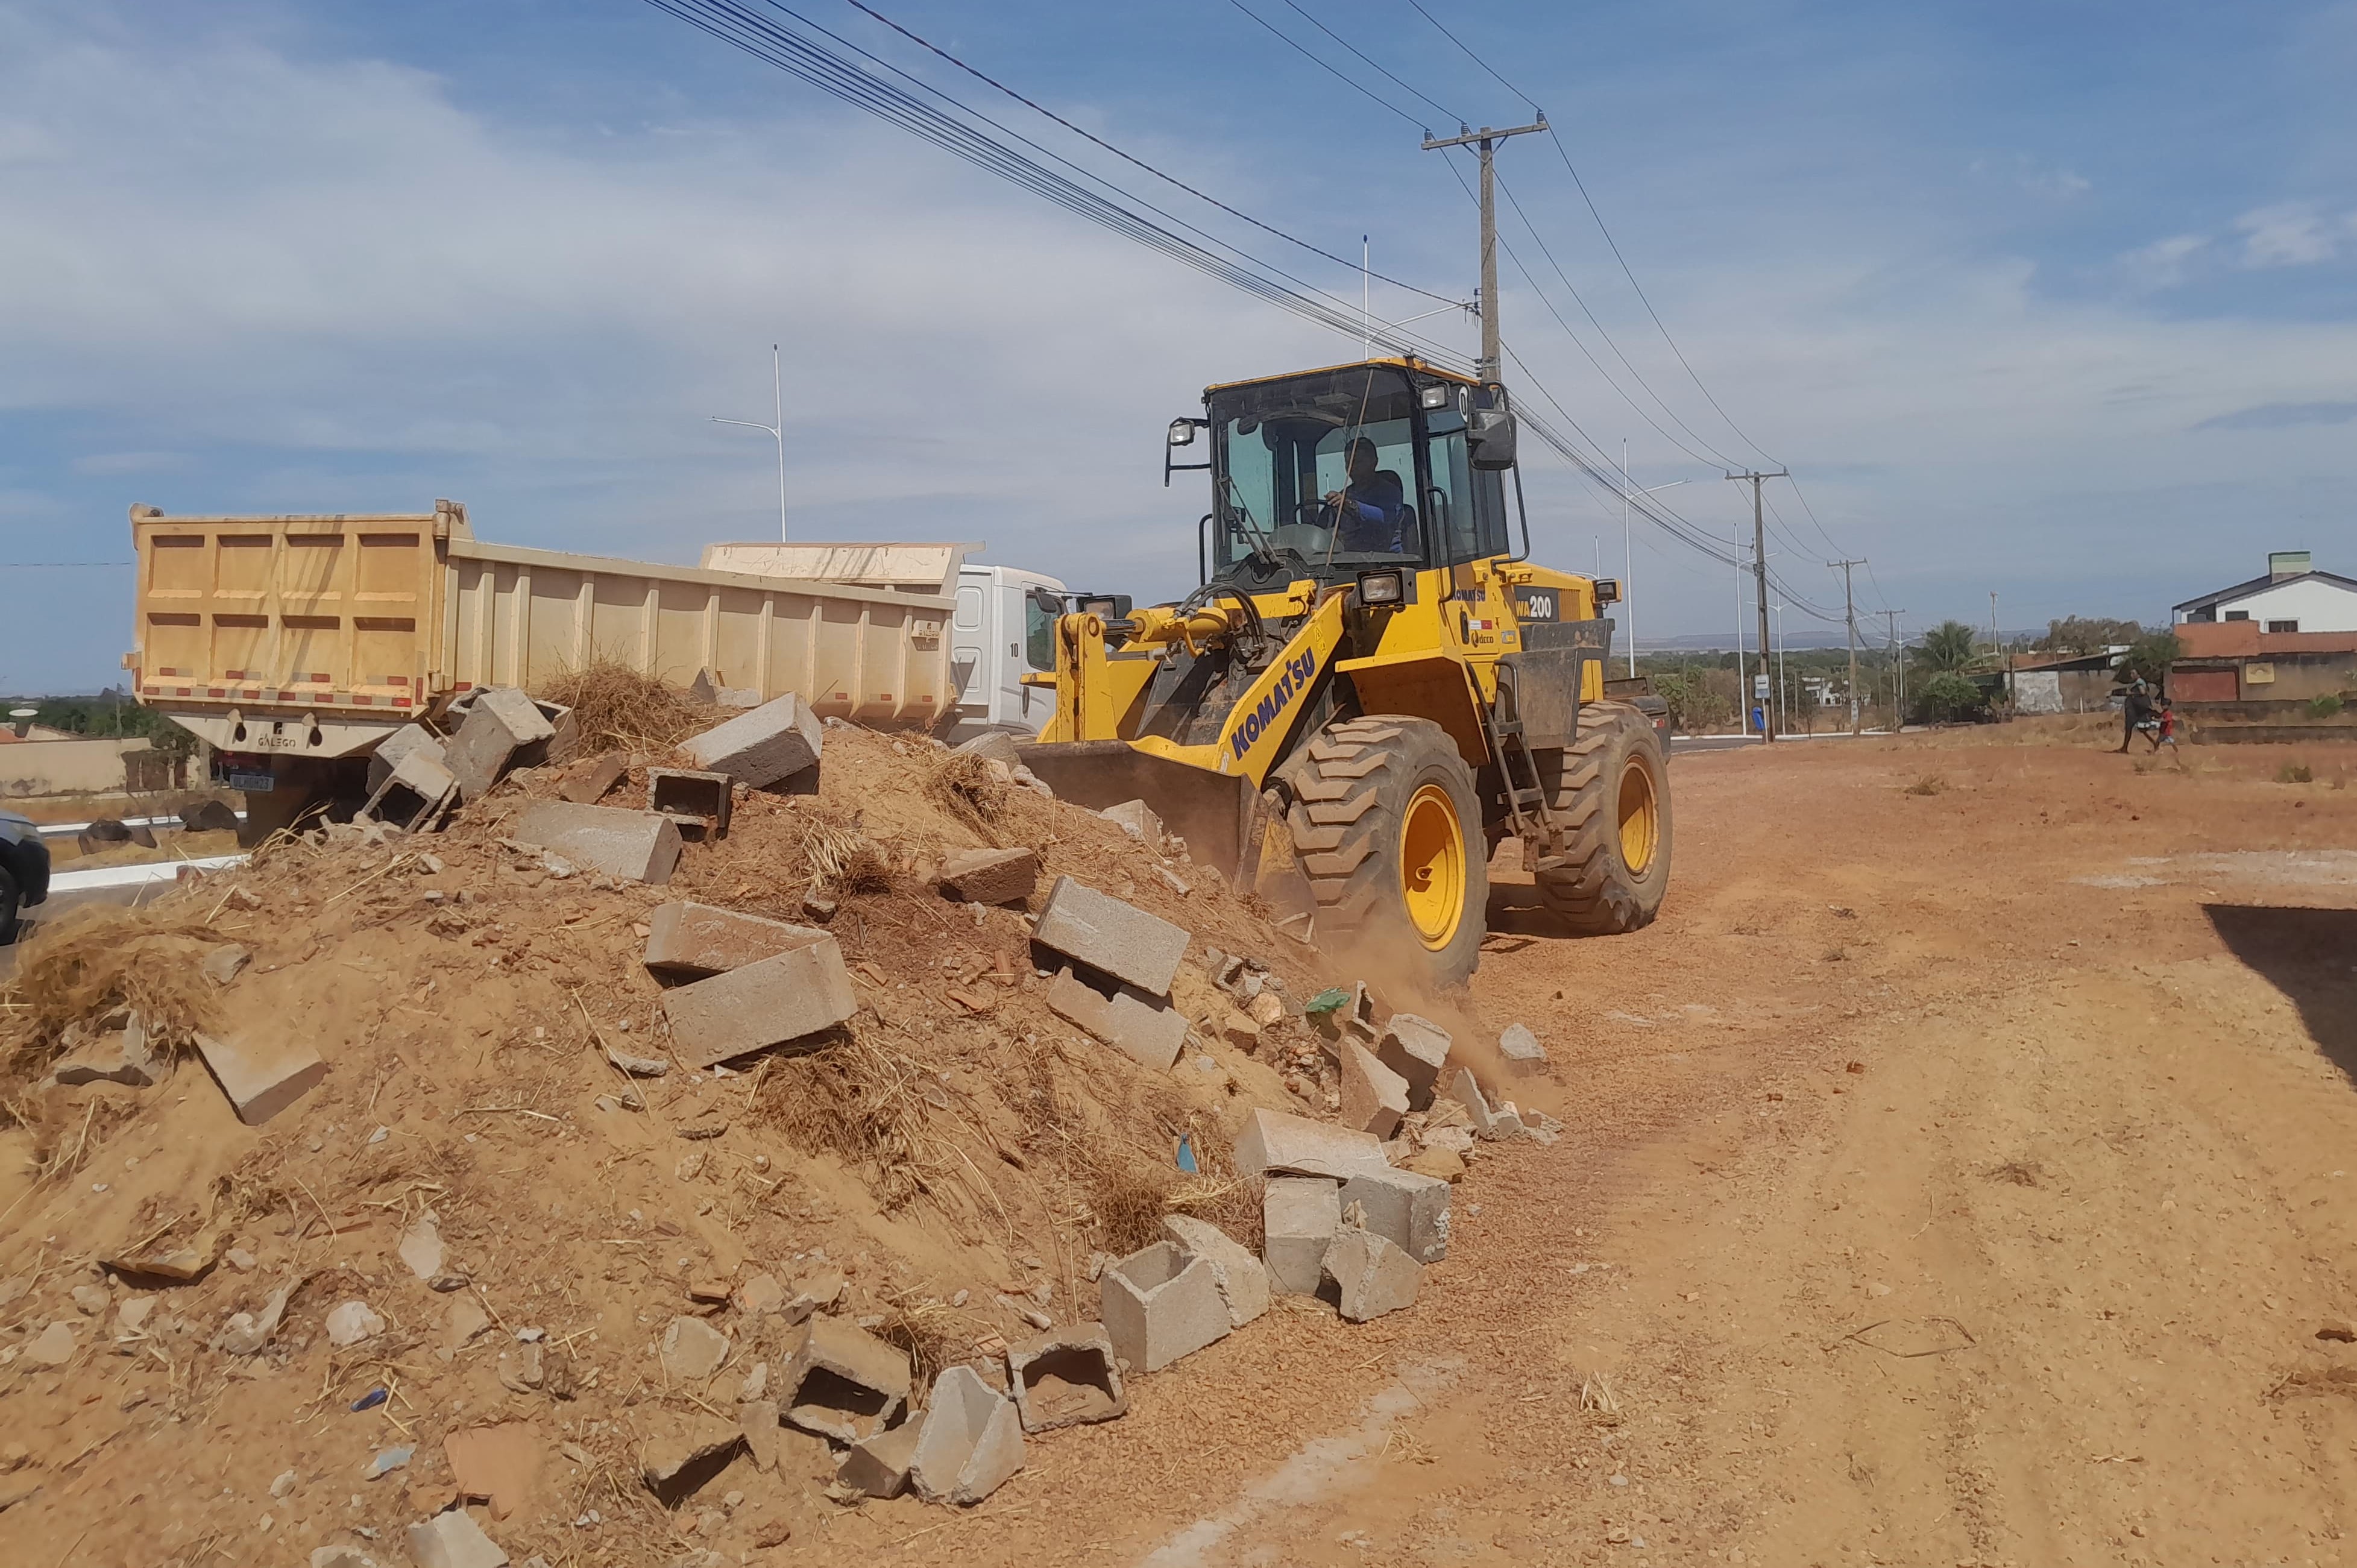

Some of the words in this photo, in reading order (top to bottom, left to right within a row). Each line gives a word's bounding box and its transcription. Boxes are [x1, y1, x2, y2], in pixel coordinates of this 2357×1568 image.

[1010, 643, 1019, 657] 10
[1231, 646, 1315, 761] KOMATSU
[258, 737, 296, 748] GALEGO
